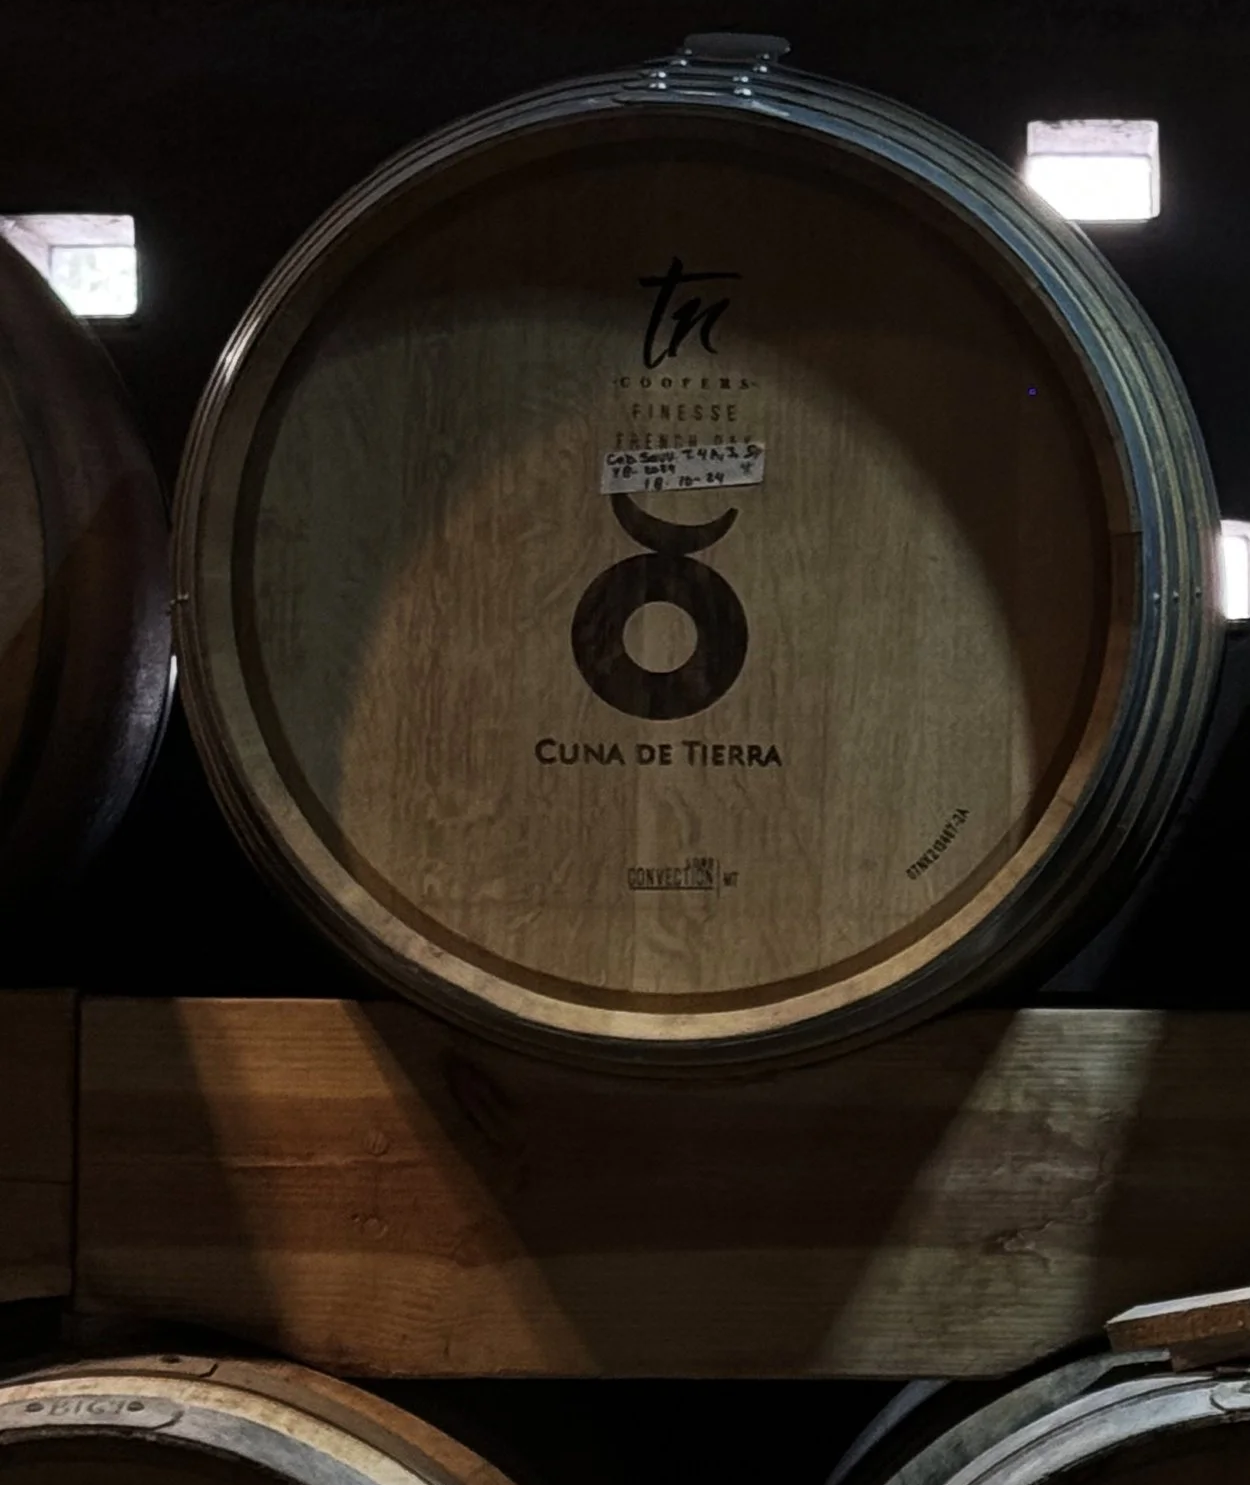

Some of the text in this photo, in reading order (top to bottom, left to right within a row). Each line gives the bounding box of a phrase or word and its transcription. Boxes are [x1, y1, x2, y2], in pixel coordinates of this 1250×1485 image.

[619, 376, 751, 390] COOPERS
[631, 403, 738, 422] FINESSE
[534, 738, 783, 767] CUNA DE TIERRA
